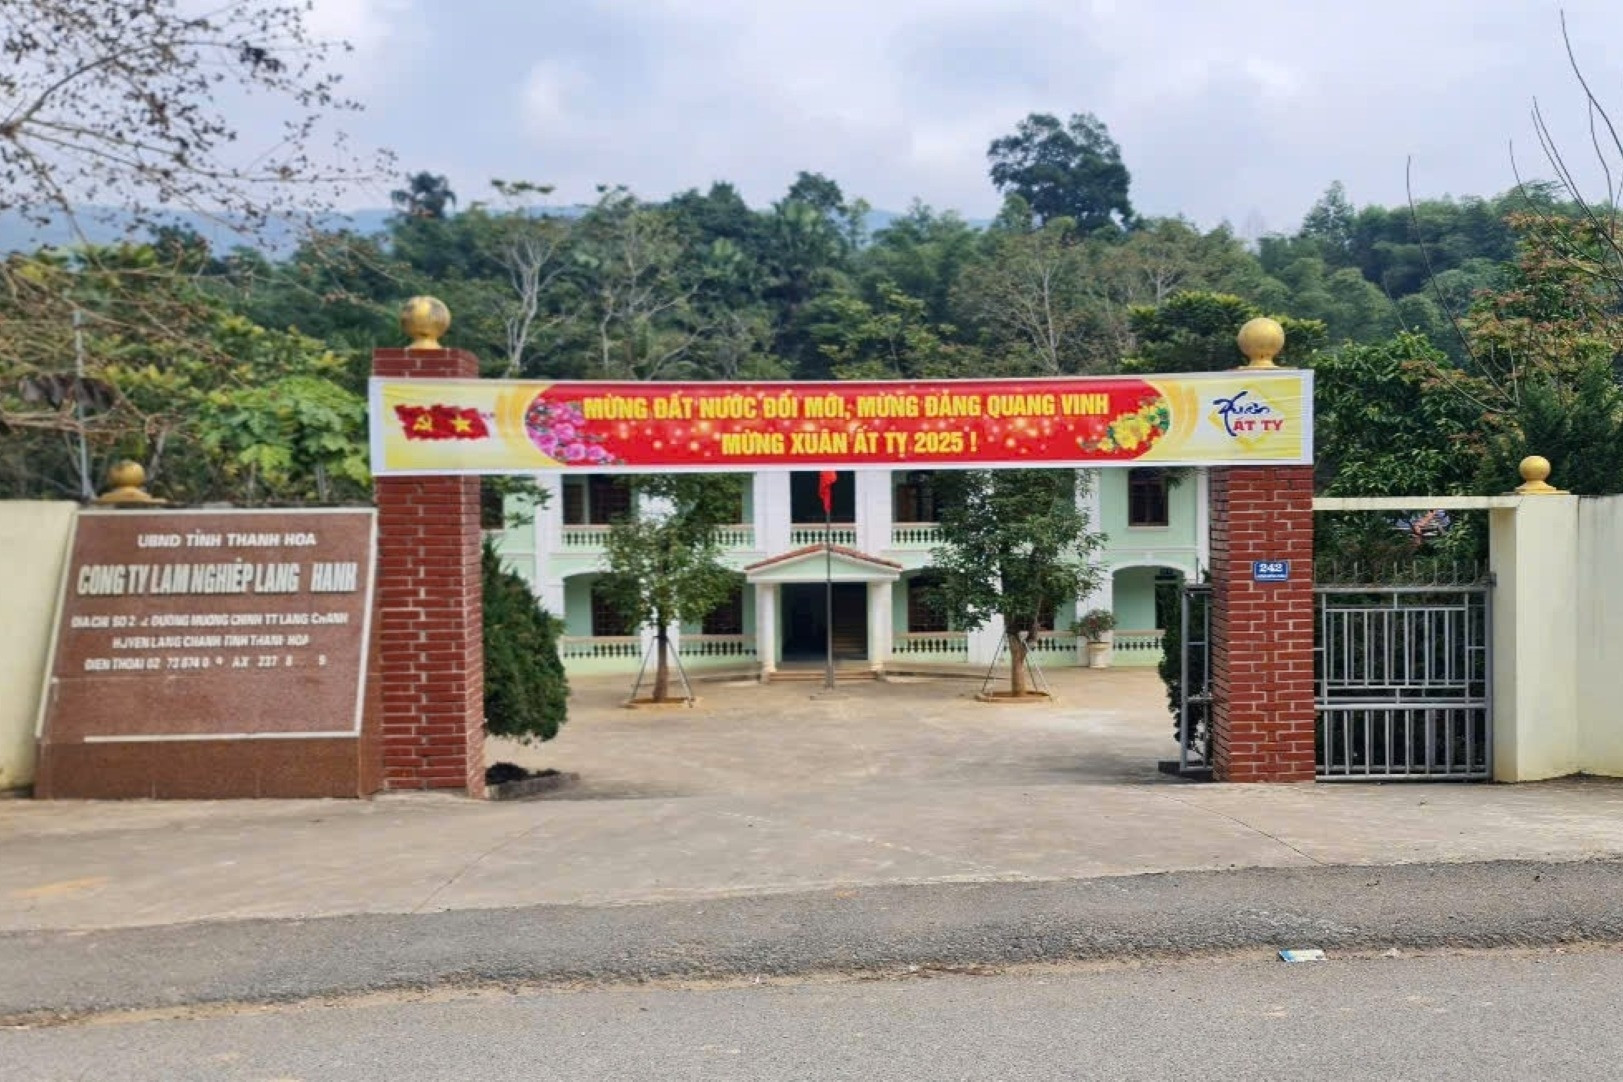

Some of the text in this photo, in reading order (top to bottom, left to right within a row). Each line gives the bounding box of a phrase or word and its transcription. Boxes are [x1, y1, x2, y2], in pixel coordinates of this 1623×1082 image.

[583, 393, 648, 419] MỪNG
[653, 391, 693, 419] ĐẤT
[699, 392, 757, 419] NƯỚC
[763, 390, 798, 419] ĐỔI
[857, 391, 919, 418] MỪNG
[924, 390, 981, 418] ĐẢNG
[987, 393, 1056, 419] QUANG
[1061, 392, 1110, 415] VINH
[721, 428, 785, 455] MỪNG
[790, 428, 848, 454] XUÂN
[853, 427, 879, 454] ẤT
[914, 431, 964, 454] 2025
[137, 533, 181, 548] UBND
[226, 532, 281, 547] THANH
[128, 563, 150, 594] TY
[254, 562, 300, 593] LANG
